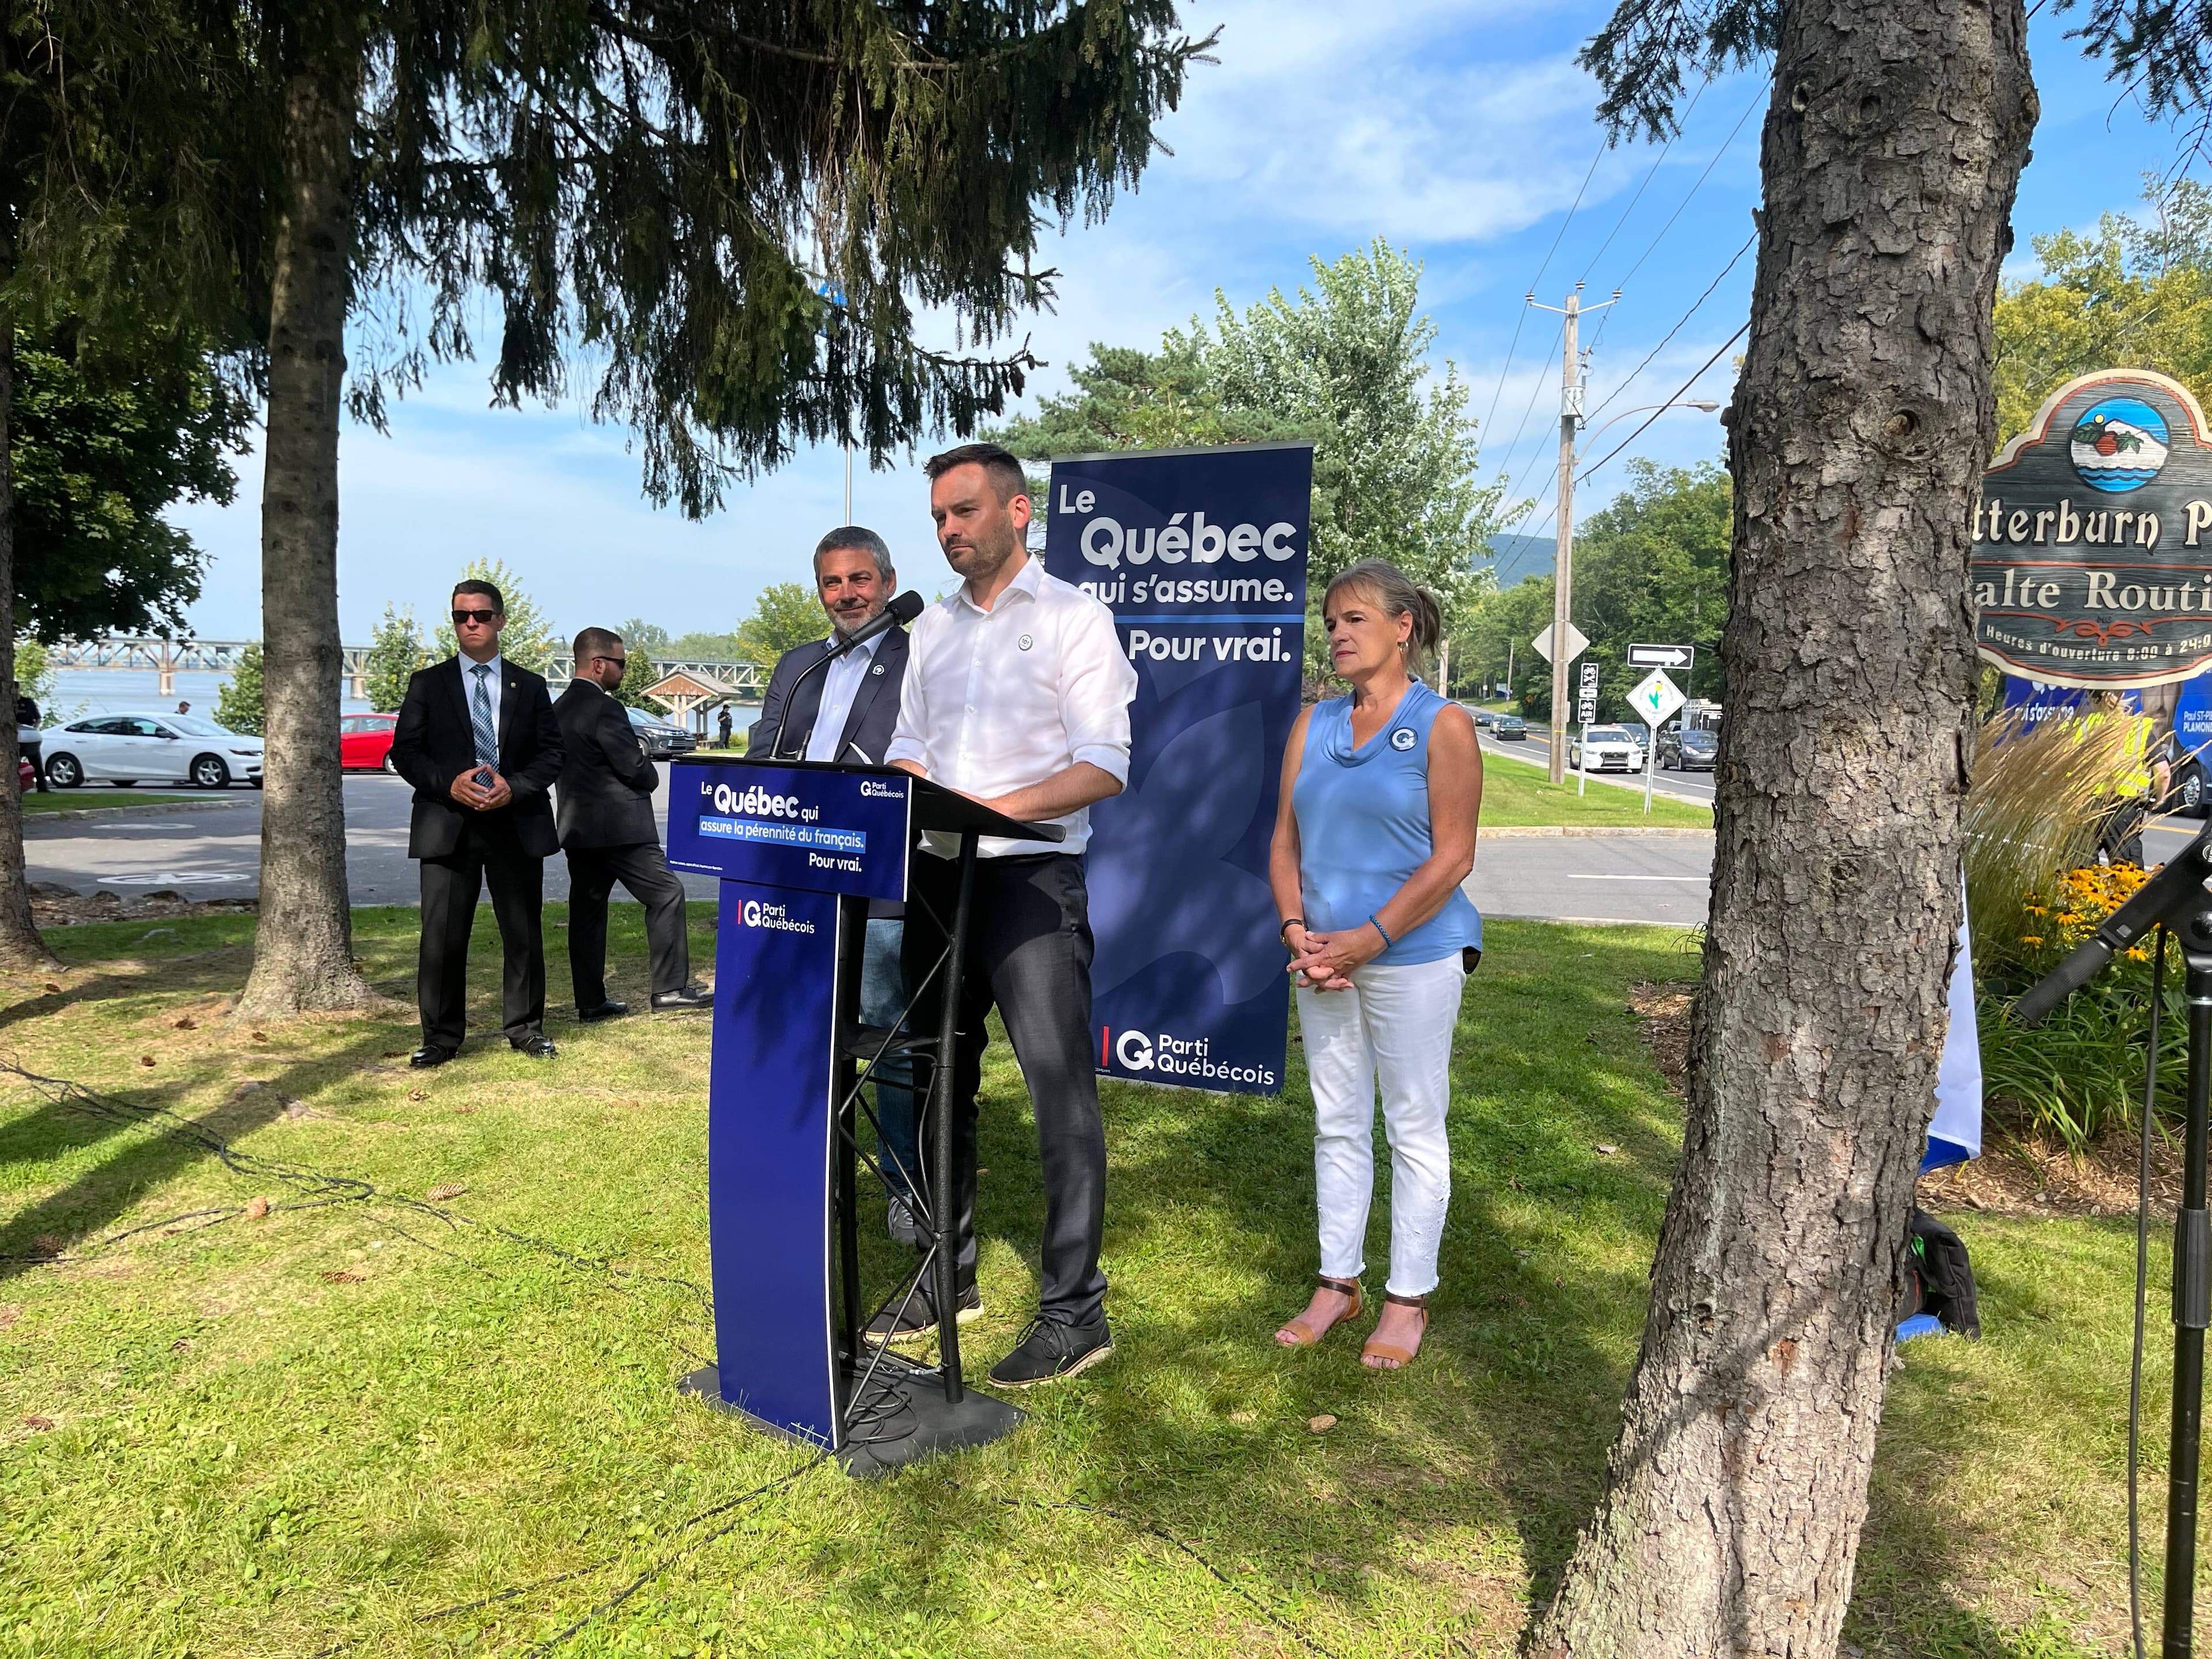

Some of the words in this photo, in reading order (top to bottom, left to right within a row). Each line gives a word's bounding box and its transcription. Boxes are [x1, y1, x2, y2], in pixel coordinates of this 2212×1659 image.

[1059, 484, 1096, 514] Le
[1080, 512, 1297, 570] Québec
[1132, 574, 1294, 603] s'assume.
[1129, 629, 1206, 661] Pour
[1213, 627, 1291, 662] vrai.
[1987, 624, 2032, 651] Heures
[2039, 642, 2120, 661] d'ouverture
[2126, 646, 2158, 661] 8:00
[2165, 643, 2172, 656] à
[2184, 710, 2196, 721] Paul
[872, 782, 887, 790] Parti
[872, 789, 904, 798] Québécois
[700, 781, 713, 795] Le
[714, 783, 799, 818] Québec
[801, 805, 819, 823] qui
[700, 820, 732, 834] assure
[734, 821, 743, 835] la
[745, 823, 796, 841] pérennité
[798, 828, 812, 842] du
[815, 829, 864, 850] français.
[809, 853, 835, 869] Pour
[837, 857, 862, 872] vrai.
[762, 915, 815, 934] Québécois
[763, 903, 786, 917] Parti
[1158, 1034, 1209, 1056] Parti
[1157, 1054, 1274, 1086] Québécois
